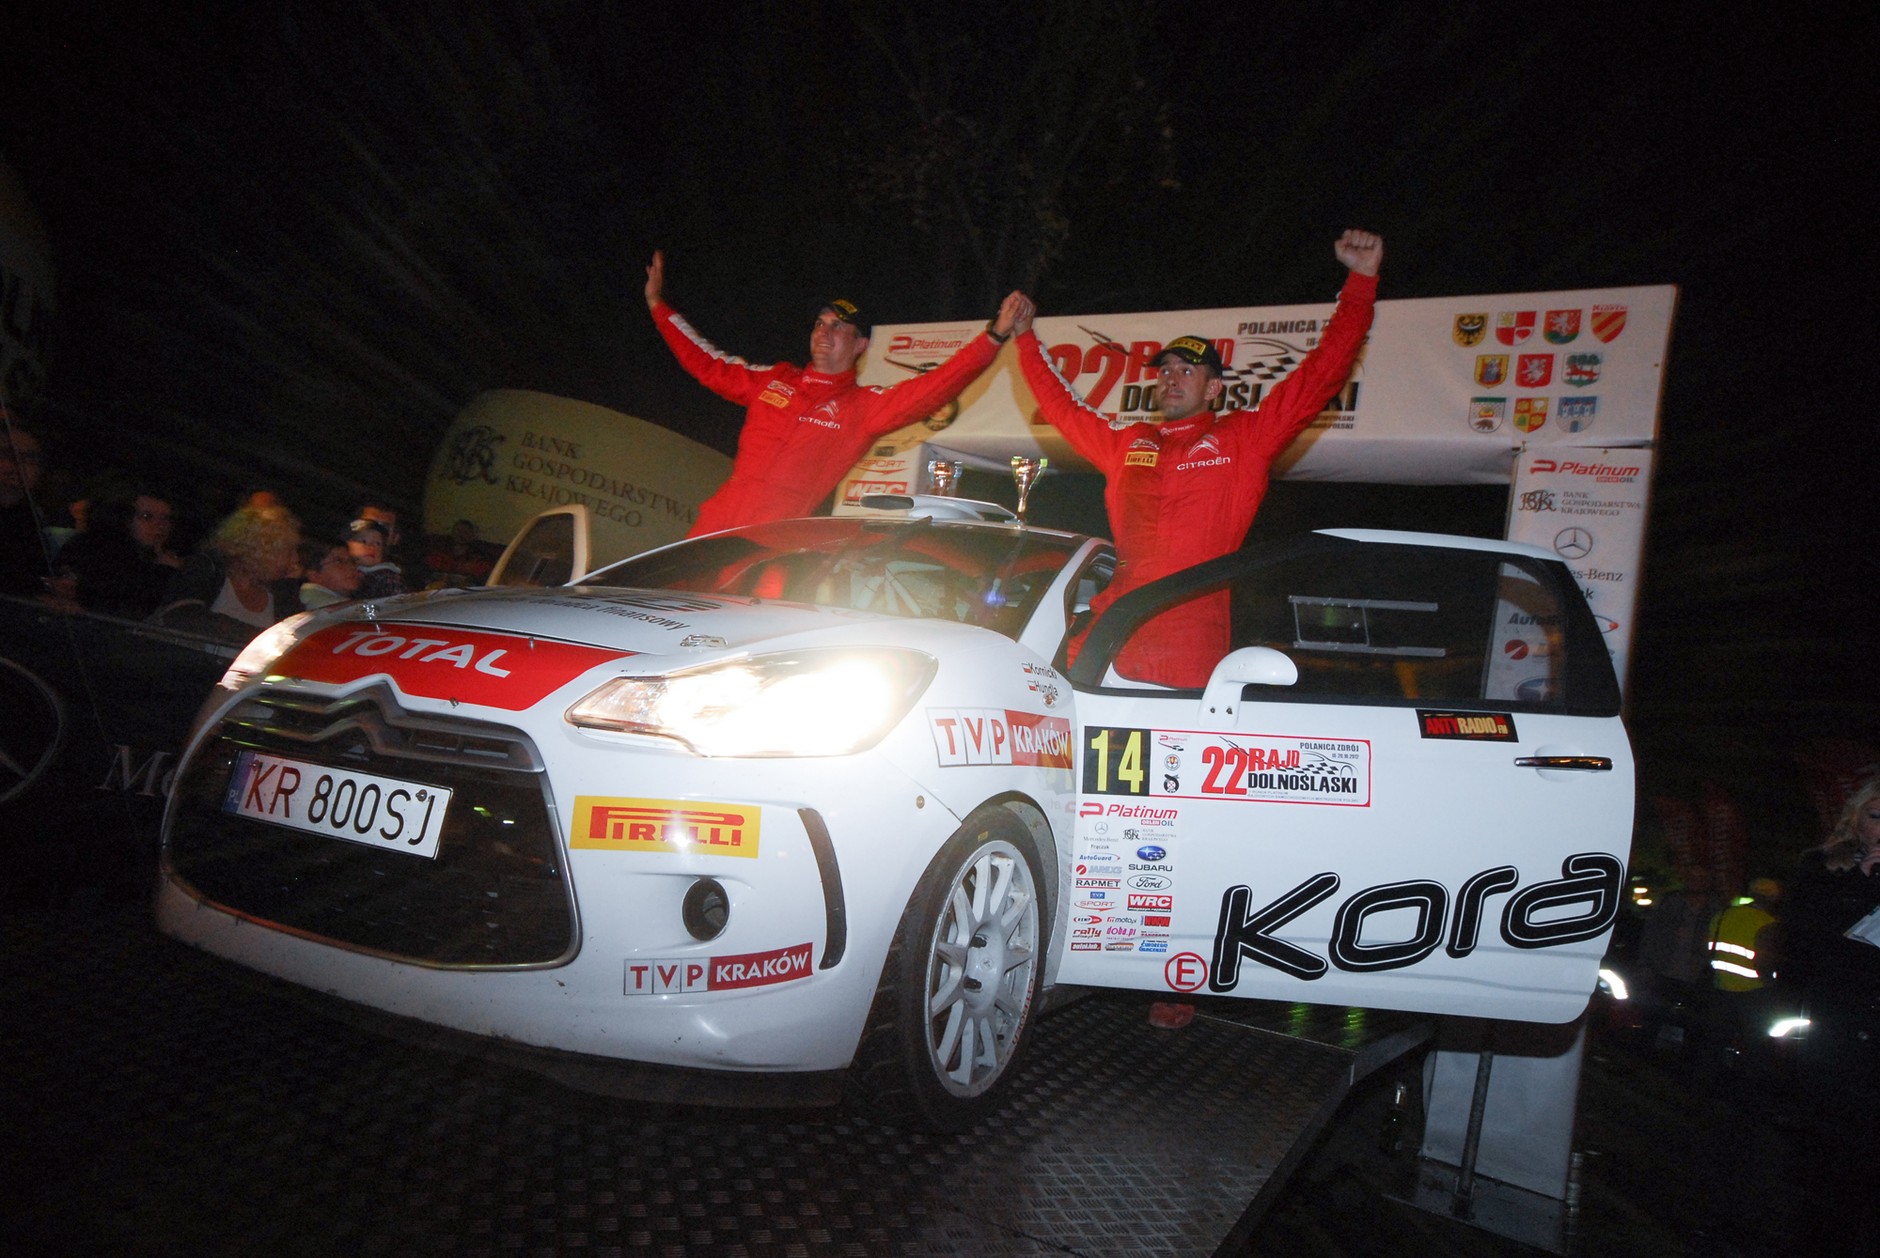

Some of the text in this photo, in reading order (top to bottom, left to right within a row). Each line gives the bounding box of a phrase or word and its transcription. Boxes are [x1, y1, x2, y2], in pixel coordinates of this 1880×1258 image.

[1237, 319, 1317, 335] POLANICA
[911, 338, 963, 350] Platinum
[521, 430, 582, 460] BANK
[1176, 456, 1231, 471] CITROËN
[1558, 461, 1641, 477] Platinum
[511, 452, 694, 525] GOSPODARSTWA
[1562, 491, 1589, 499] BANK
[504, 473, 643, 528] KRAJOWEGO
[1561, 499, 1641, 510] GOSPODARSTWA
[1560, 508, 1621, 516] KRAJOWEGO
[597, 605, 691, 631] finansowy
[331, 631, 512, 679] TOTAL
[934, 716, 1069, 757] TVP KRAKÓW
[1299, 742, 1336, 751] POLANICA
[1090, 729, 1144, 794] 14
[1201, 745, 1301, 795] 22 RAJD
[244, 761, 436, 846] KR 800SJ
[1106, 804, 1179, 819] Platinum
[588, 805, 746, 847] PIRELLI
[1128, 863, 1173, 872] SUBARU
[1075, 880, 1120, 888] RAPMET
[1135, 876, 1164, 889] Ford
[1128, 895, 1171, 907] WRC
[1208, 852, 1625, 993] Kora
[629, 951, 809, 990] TVP KRAKÓW
[1174, 959, 1197, 987] E
